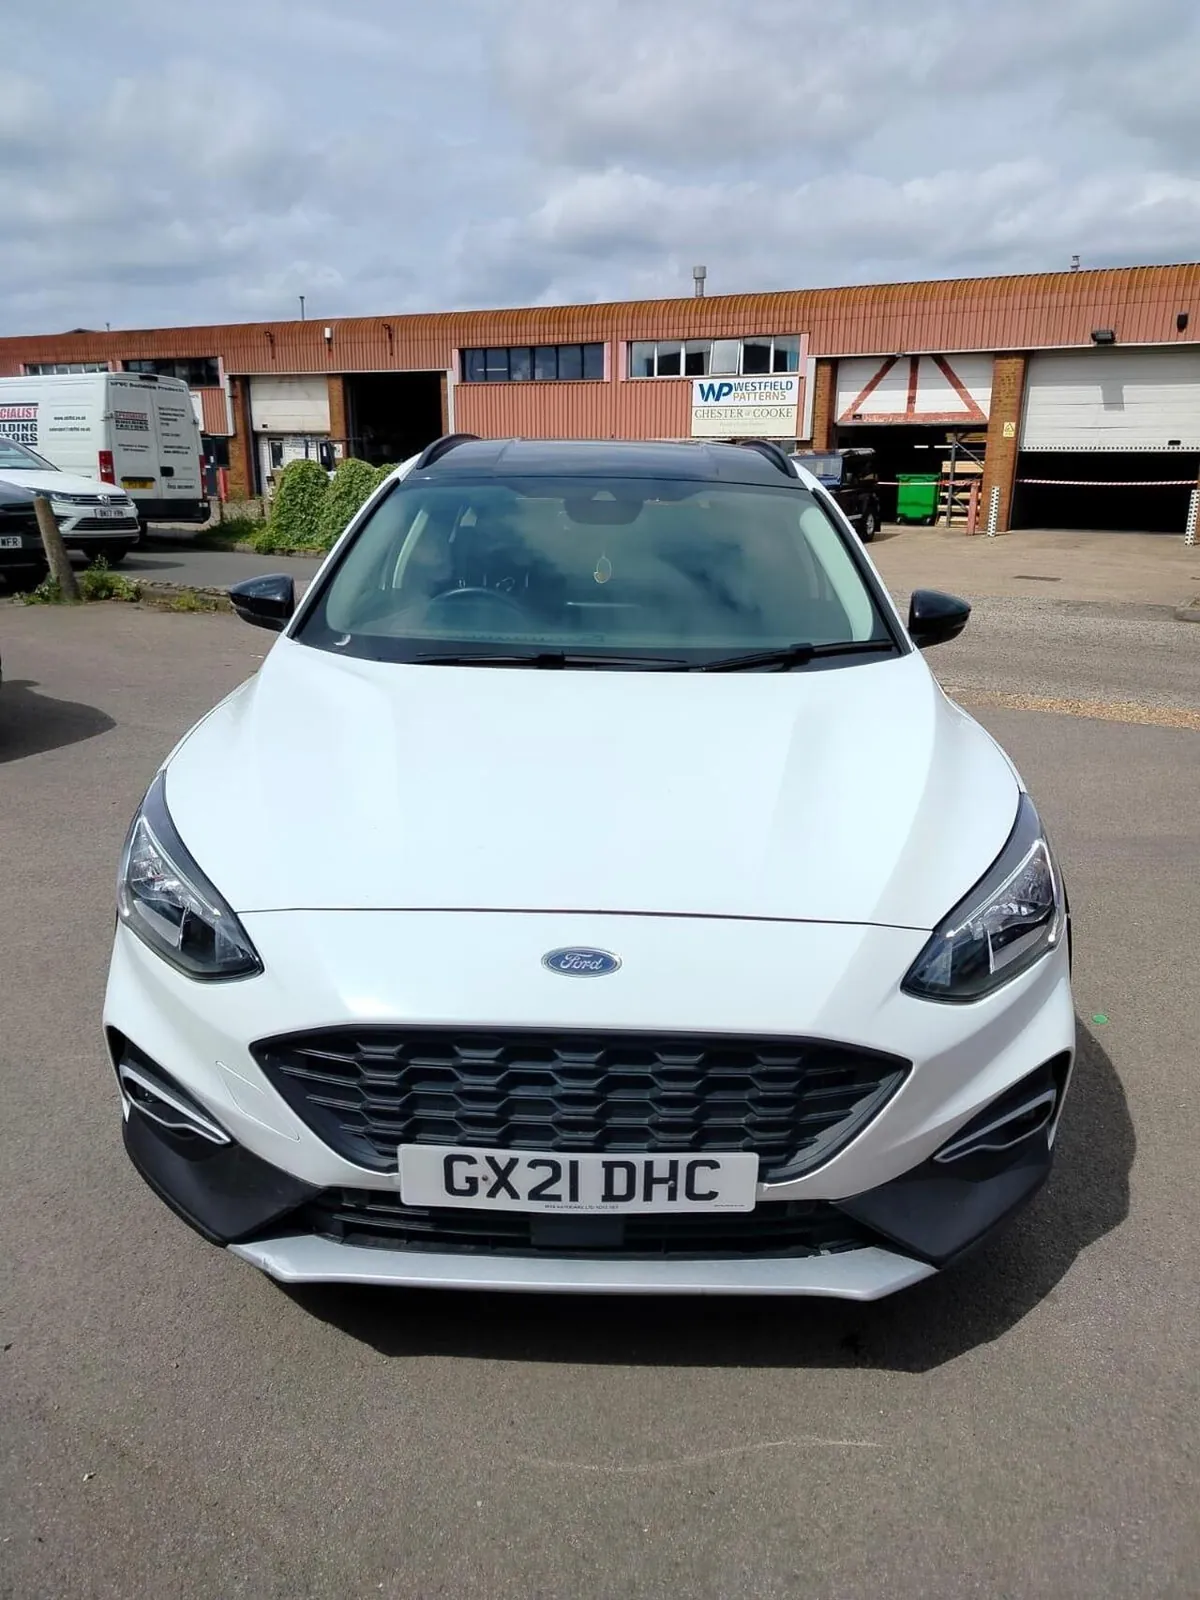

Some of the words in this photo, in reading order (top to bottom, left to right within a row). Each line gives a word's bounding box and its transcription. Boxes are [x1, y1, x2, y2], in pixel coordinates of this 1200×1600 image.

[698, 382, 734, 402] WP
[734, 380, 793, 392] WESTFIELD
[733, 391, 787, 402] PATTERNS
[0, 407, 38, 419] CIALIST
[694, 408, 744, 419] CHESTER
[752, 408, 793, 418] COOKE
[1, 537, 18, 546] WFR
[559, 952, 604, 970] Ford
[443, 1153, 580, 1202] GX21
[601, 1159, 721, 1202] DHC
